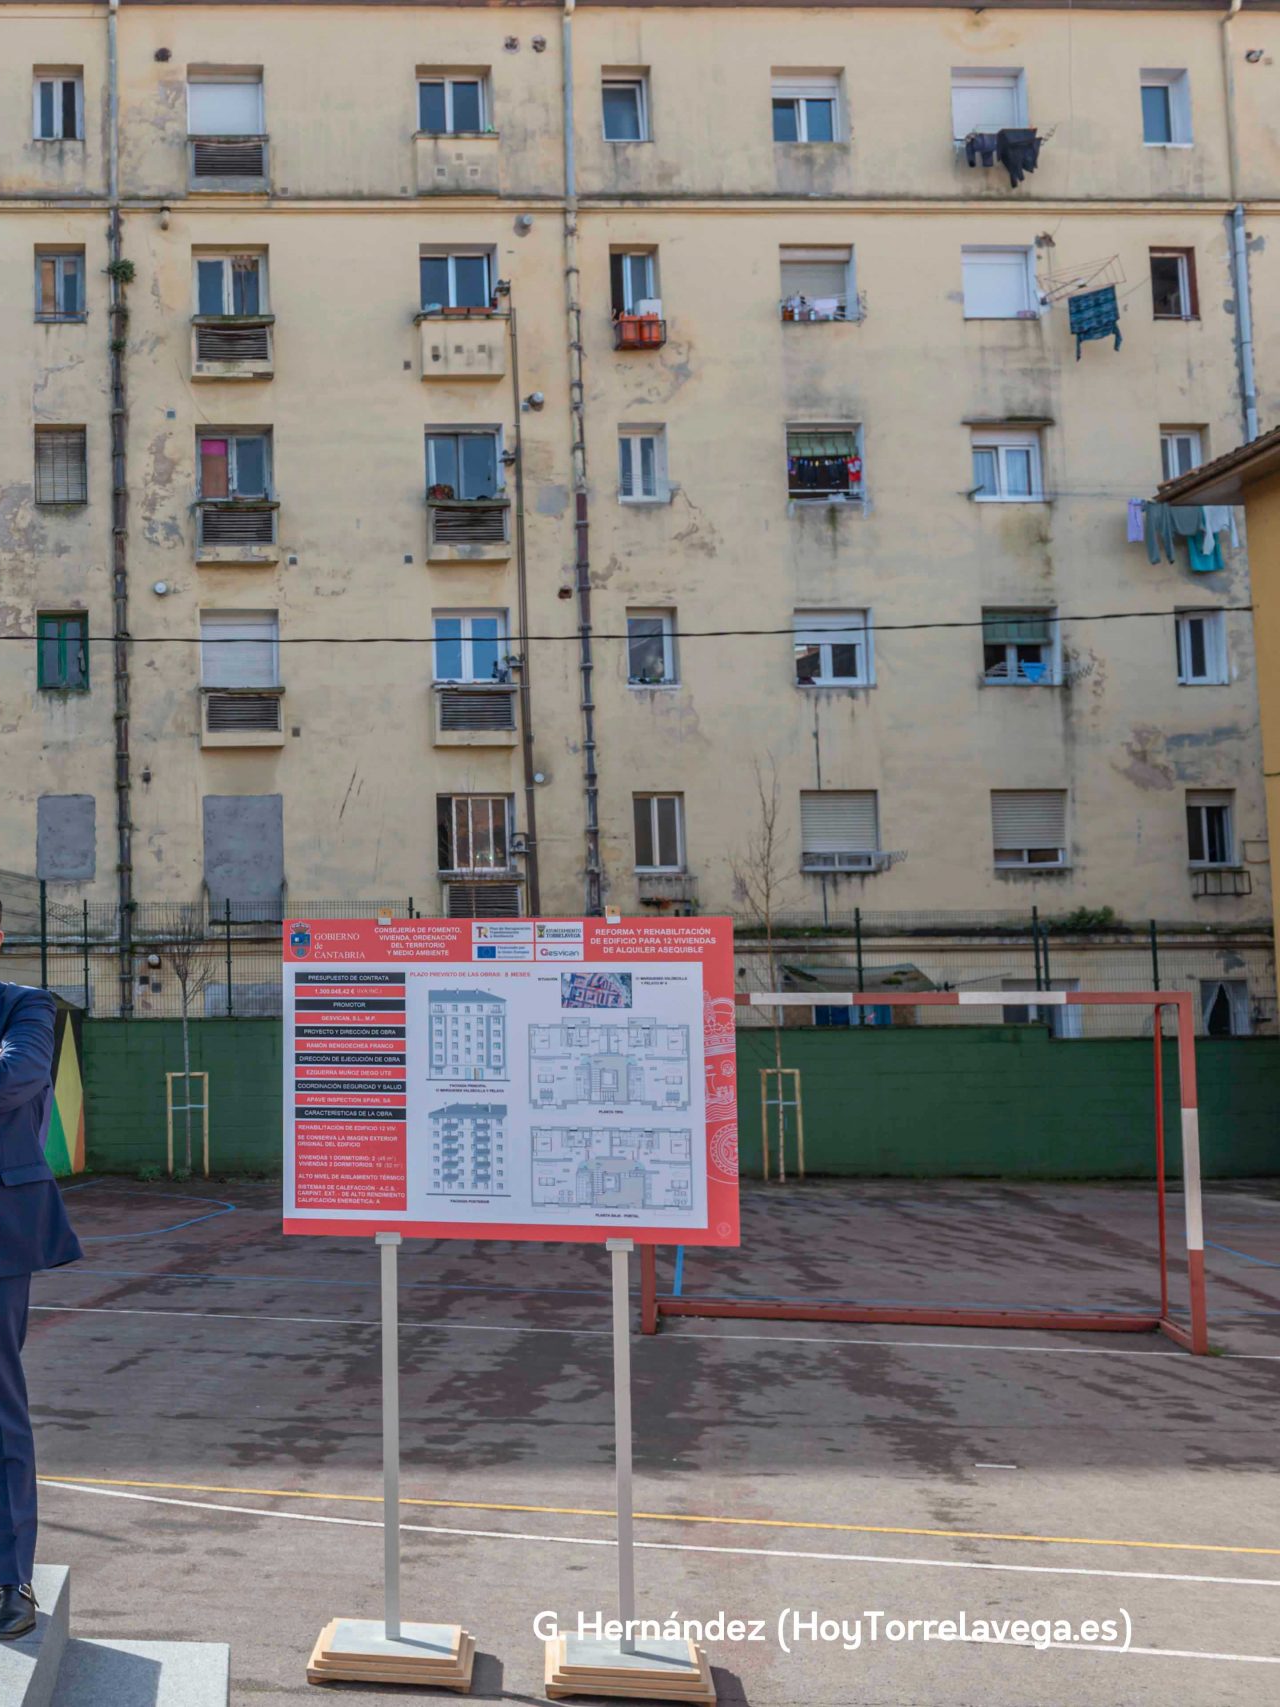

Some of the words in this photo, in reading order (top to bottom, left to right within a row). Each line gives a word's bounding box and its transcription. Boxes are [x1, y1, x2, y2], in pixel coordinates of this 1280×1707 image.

[643, 927, 711, 935] REHABILITACIÓN
[314, 932, 360, 941] GOBIERNO
[412, 933, 457, 941] ORDENACIÓN
[314, 951, 366, 960] CANTABRIA
